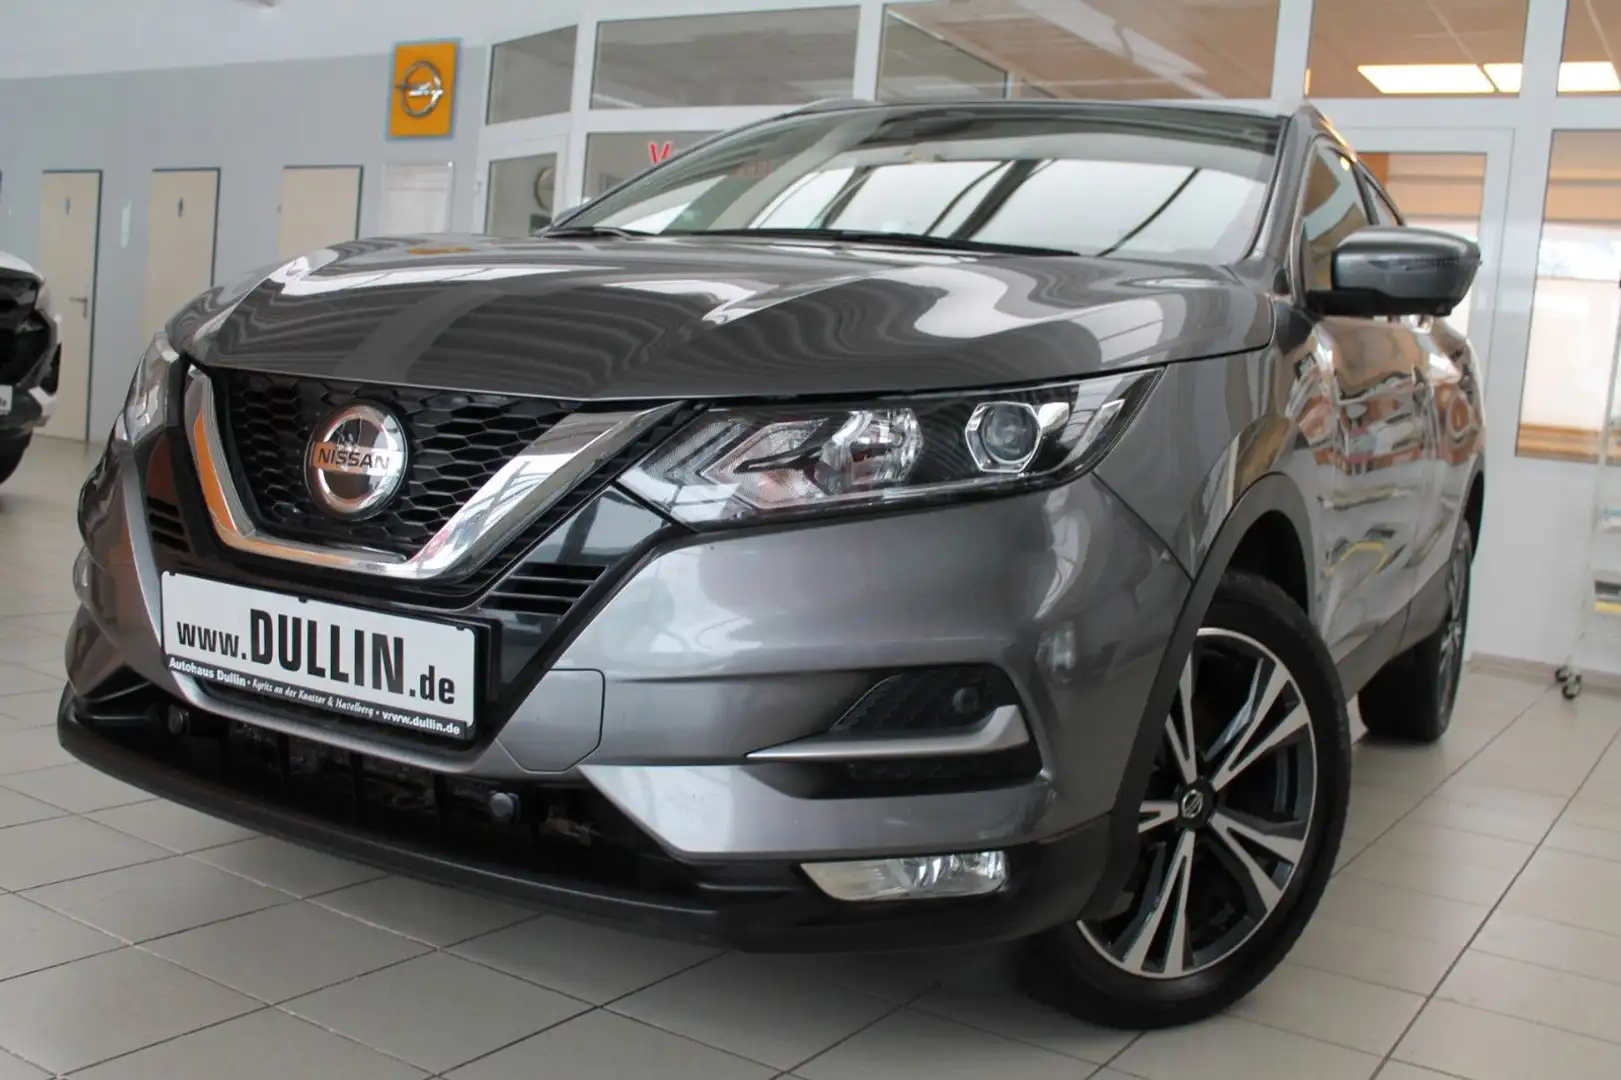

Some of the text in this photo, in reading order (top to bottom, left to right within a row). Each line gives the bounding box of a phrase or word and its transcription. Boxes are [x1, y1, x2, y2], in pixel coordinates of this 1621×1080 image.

[318, 448, 390, 470] NISSAN
[176, 608, 455, 705] www.DULLIN.de
[168, 657, 215, 679] Autohaus
[216, 669, 246, 687] Dullin
[274, 686, 283, 694] an
[284, 686, 298, 698] der
[327, 696, 334, 708] &
[336, 697, 374, 718] Havelberg
[382, 711, 460, 735] www.dullin.de
